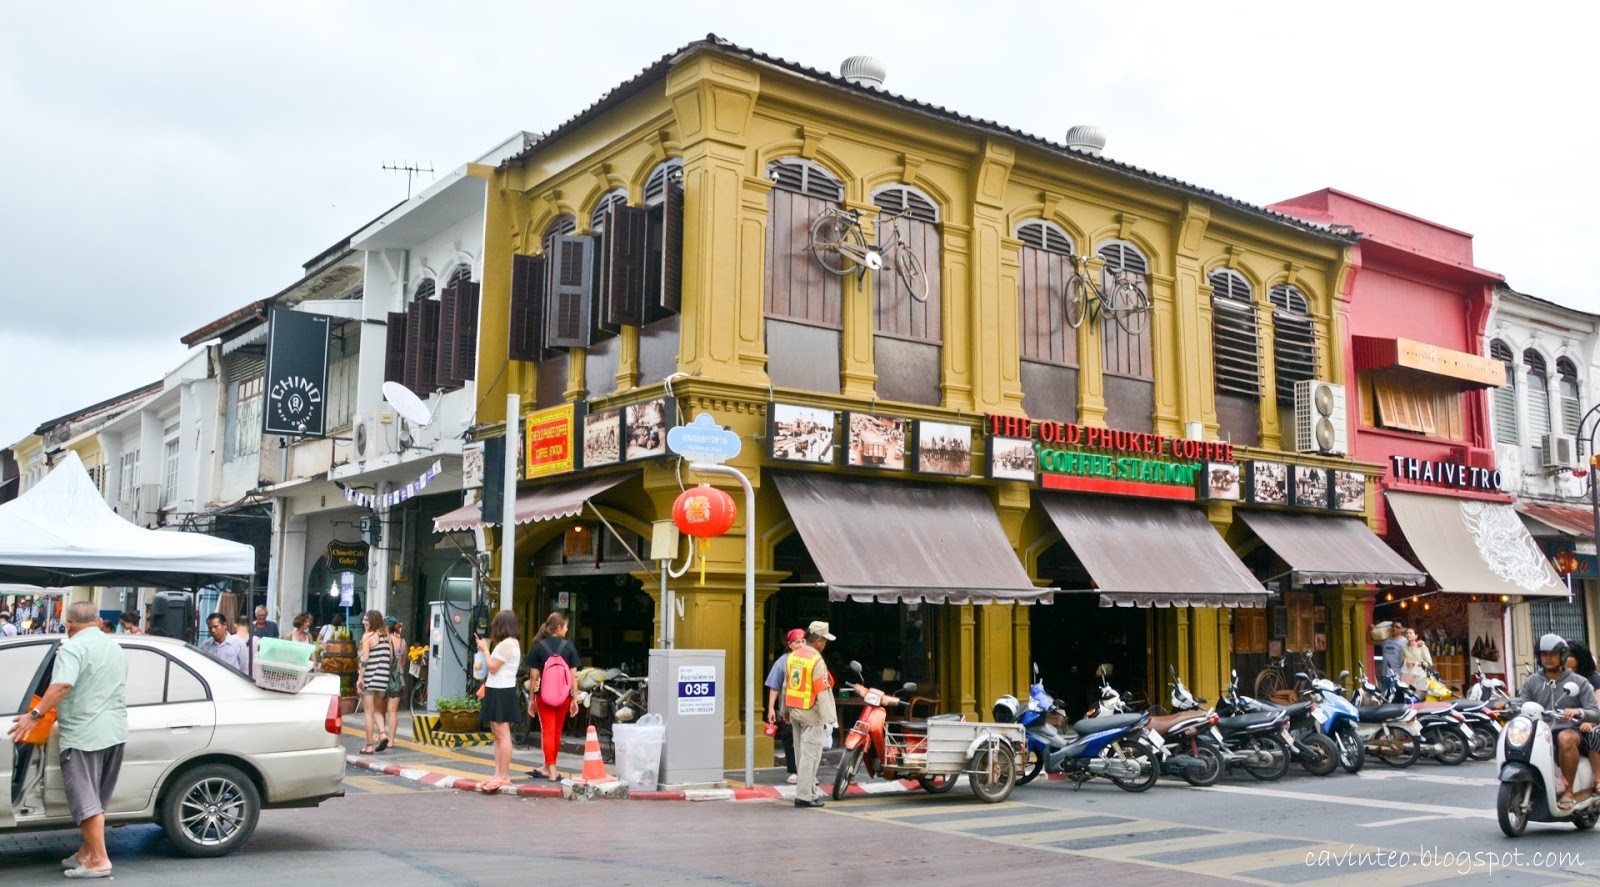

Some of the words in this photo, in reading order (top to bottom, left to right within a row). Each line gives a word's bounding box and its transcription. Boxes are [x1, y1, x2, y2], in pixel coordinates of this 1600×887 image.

[271, 376, 321, 402] CHINO
[987, 413, 1032, 439] THE
[1040, 420, 1081, 444] OLD
[1085, 426, 1166, 455] PHUKET
[1171, 438, 1235, 463] COFFEE
[1394, 455, 1503, 489] THAIVETRO
[685, 683, 709, 696] 035
